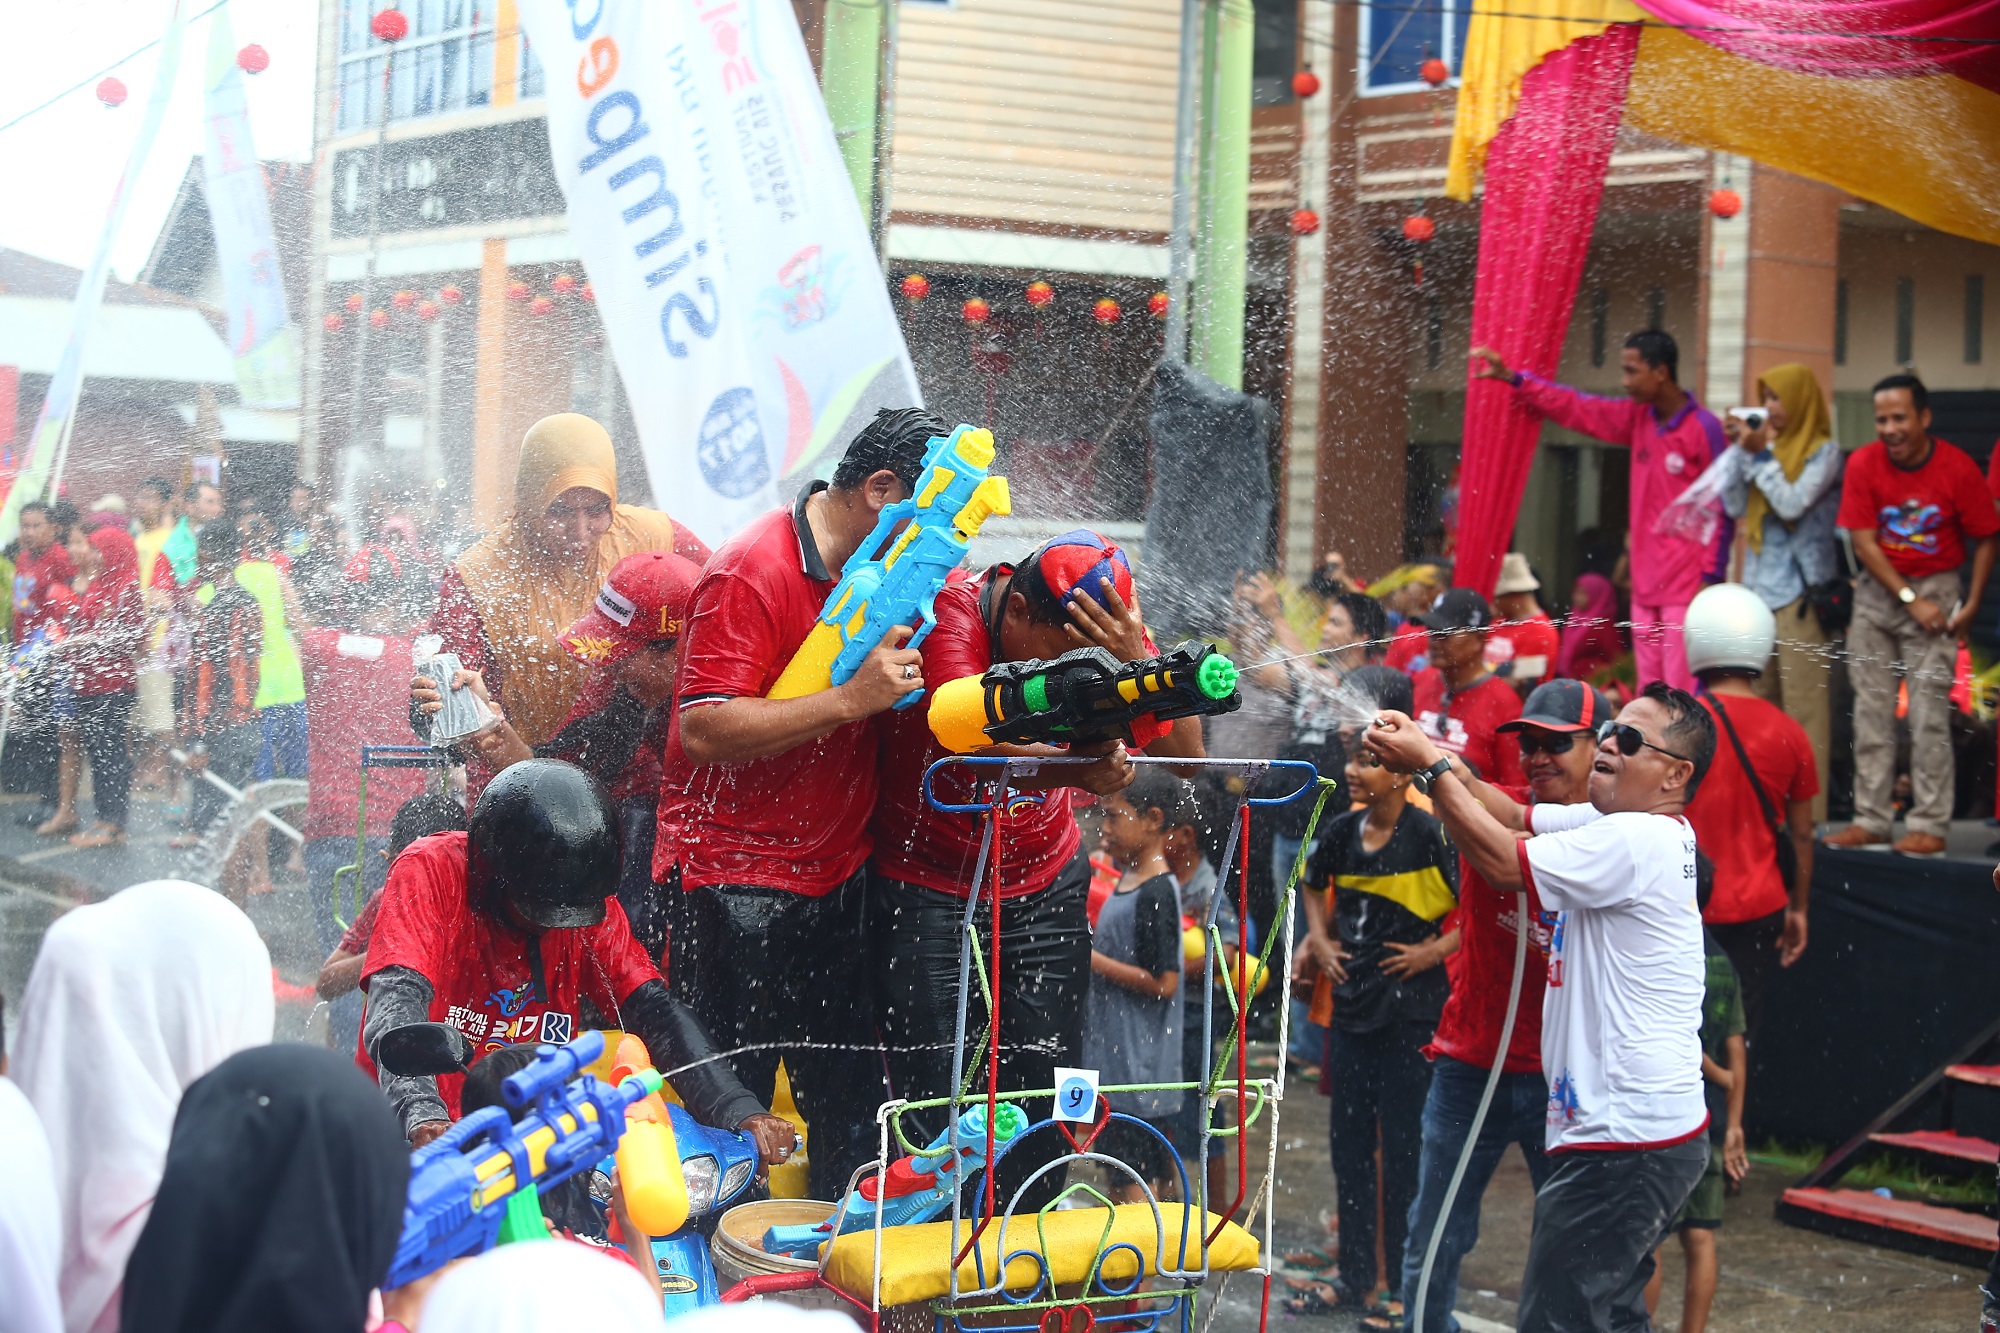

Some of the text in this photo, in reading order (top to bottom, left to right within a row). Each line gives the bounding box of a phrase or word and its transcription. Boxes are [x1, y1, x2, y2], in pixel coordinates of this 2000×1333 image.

[448, 1004, 489, 1026] ESTIVAL
[468, 1022, 487, 1036] AIR
[1068, 1086, 1084, 1108] 9
[662, 1280, 690, 1288] wasaki
